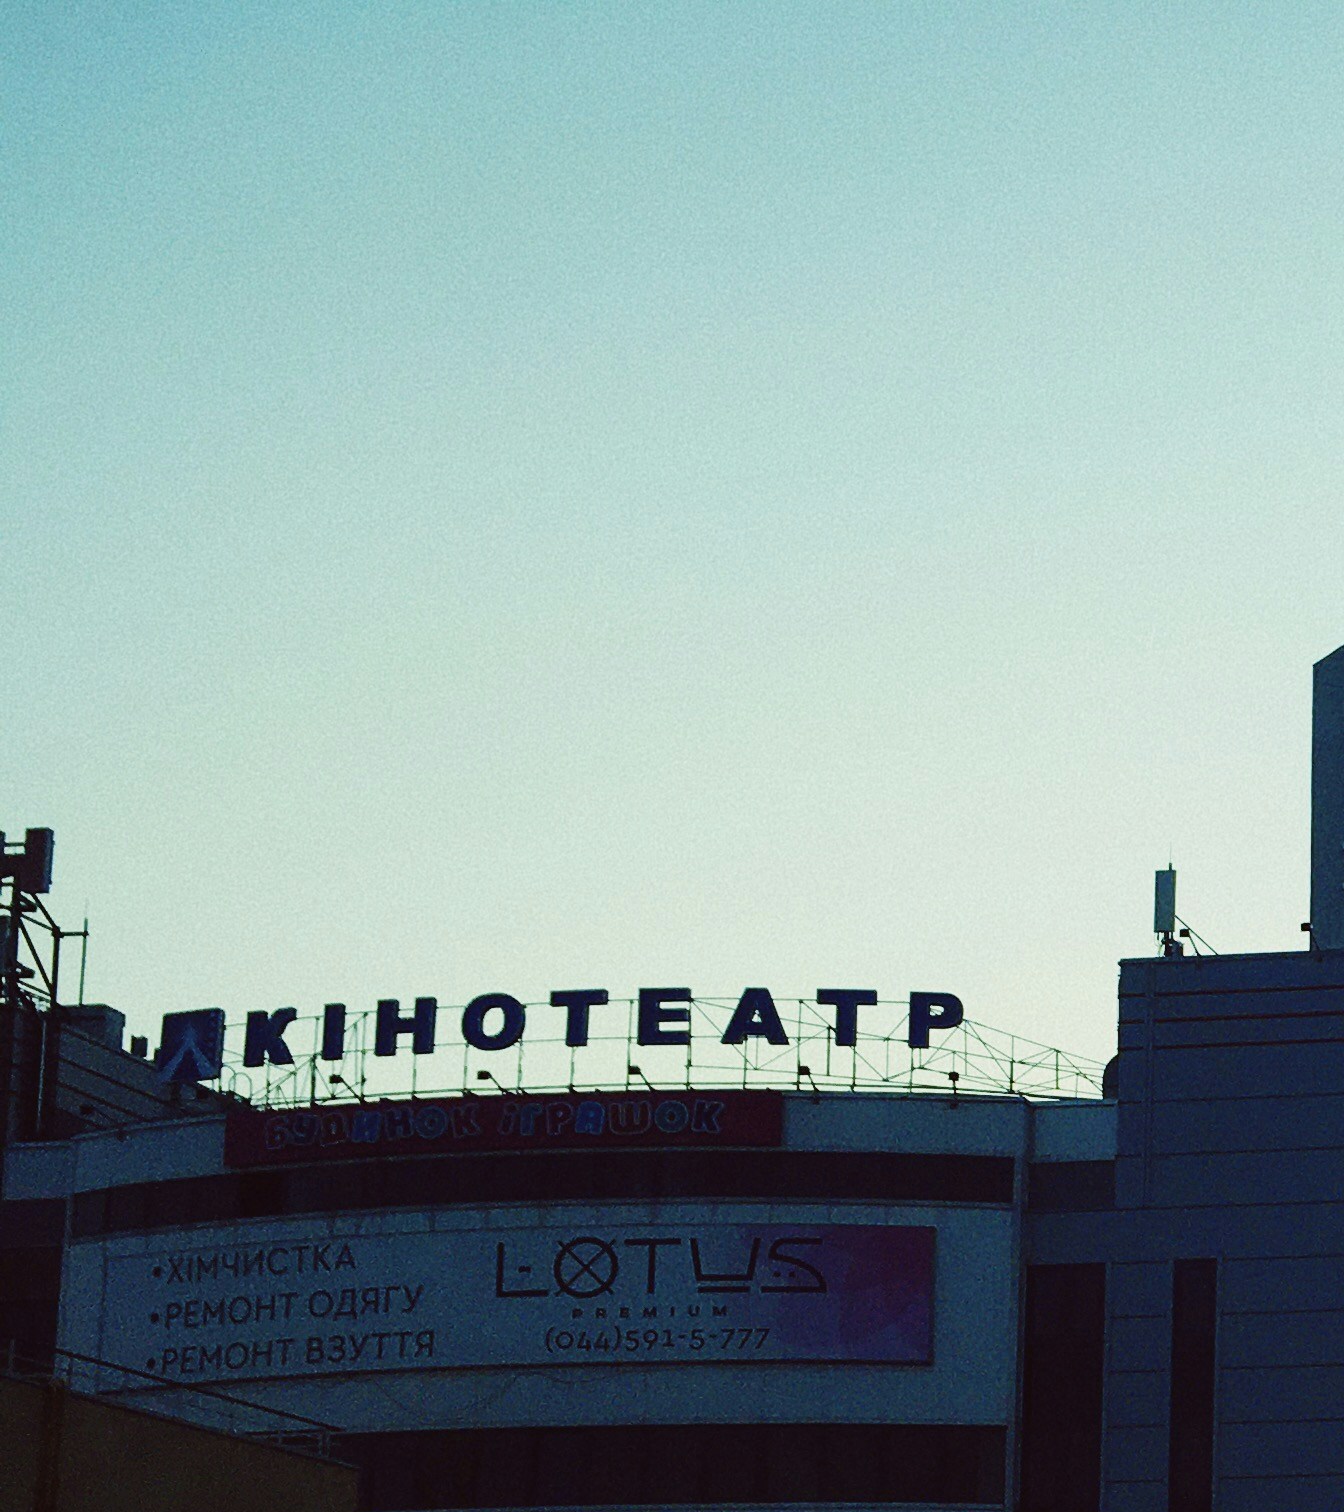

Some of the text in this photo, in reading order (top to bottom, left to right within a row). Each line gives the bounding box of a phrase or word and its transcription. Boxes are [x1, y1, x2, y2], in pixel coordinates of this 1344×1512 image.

[243, 987, 963, 1067] КІНОТЕАТР
[495, 1236, 827, 1299] LOTUS
[164, 1284, 424, 1330] РЕМОНТ ОДЯГУ
[571, 1304, 729, 1319] PREMIUM
[161, 1329, 435, 1375] РЕМОНТ ВЗУТТЯ
[545, 1326, 770, 1353] (044)591-5-777
